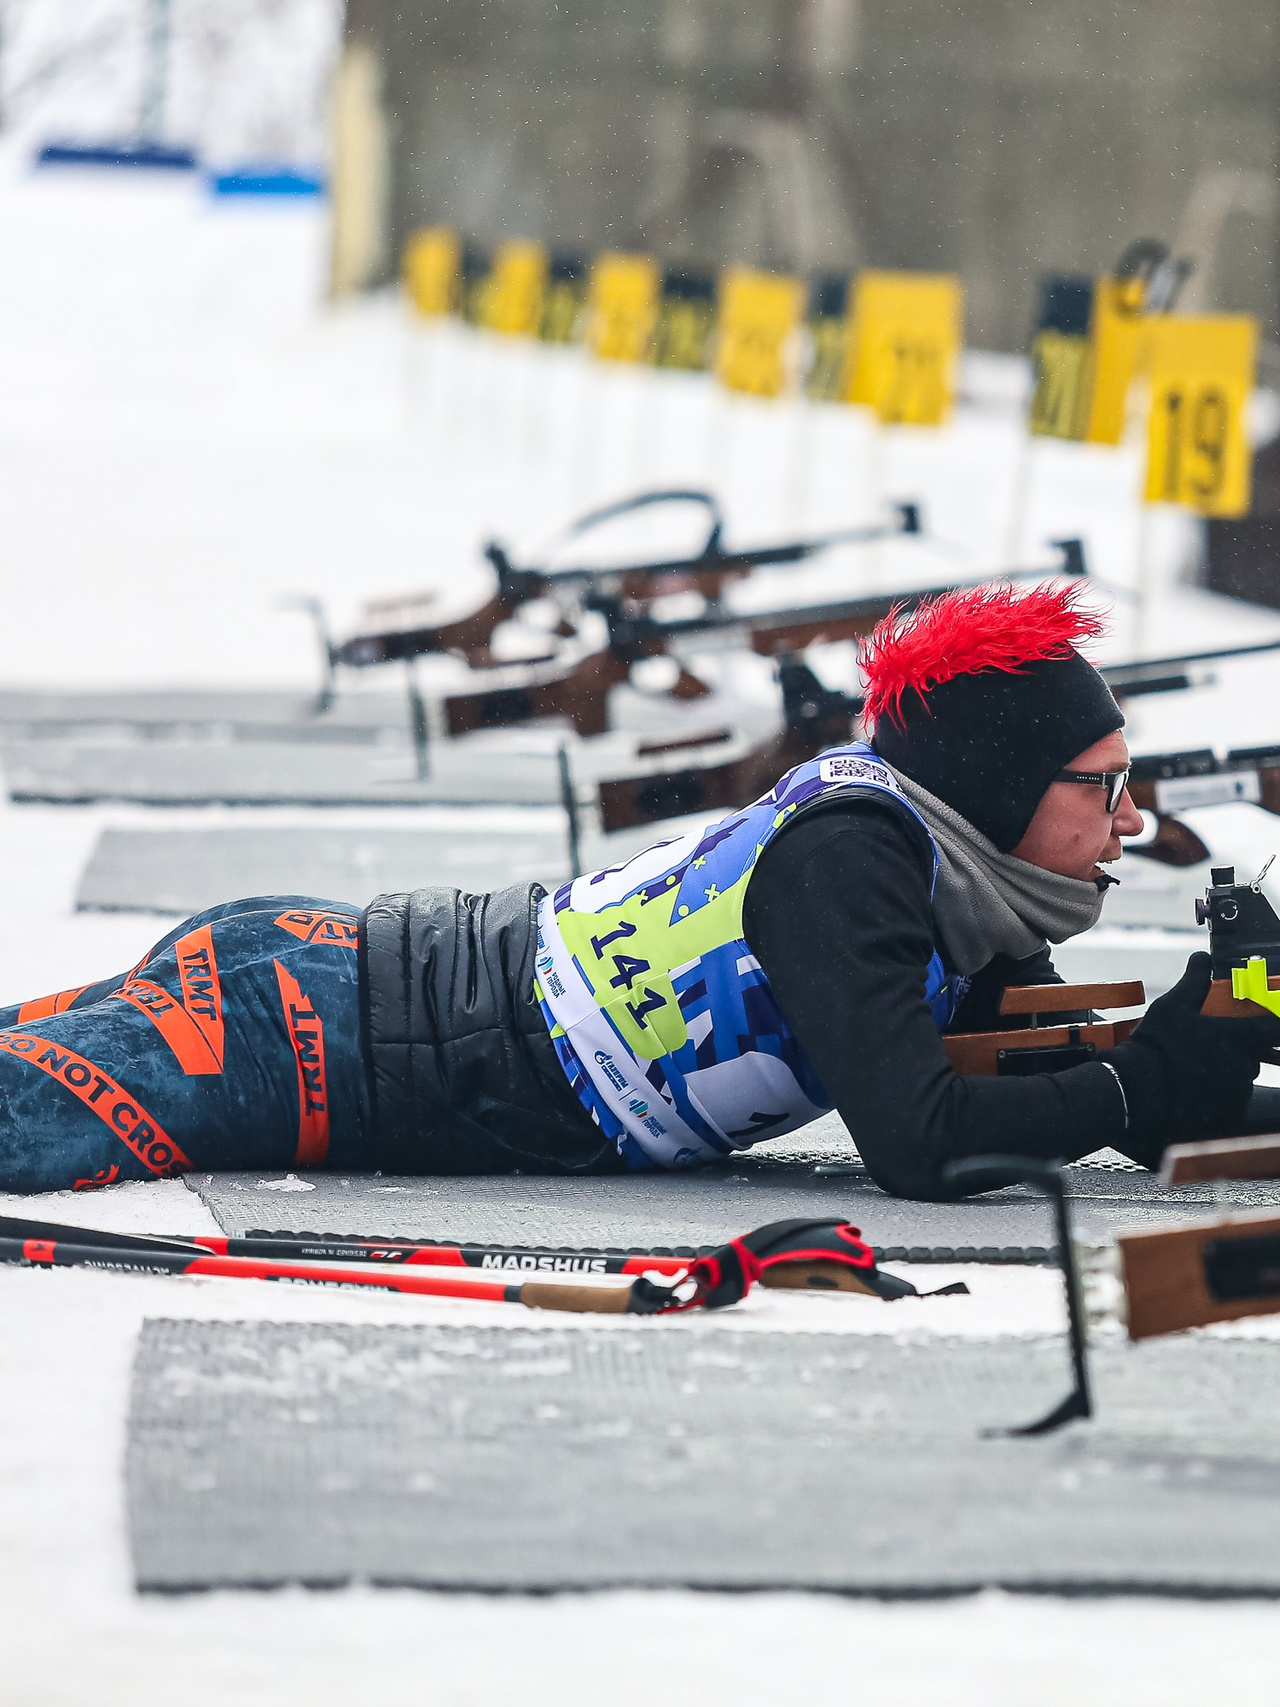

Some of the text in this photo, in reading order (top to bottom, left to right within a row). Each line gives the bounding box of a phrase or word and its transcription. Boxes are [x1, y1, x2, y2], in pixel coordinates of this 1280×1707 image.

[1161, 384, 1229, 498] 19
[182, 947, 217, 1021] TRMT
[590, 920, 668, 1031] 141
[37, 1047, 115, 1104] NOT
[289, 1003, 325, 1117] TRMT
[481, 1253, 607, 1274] MADSHUS
